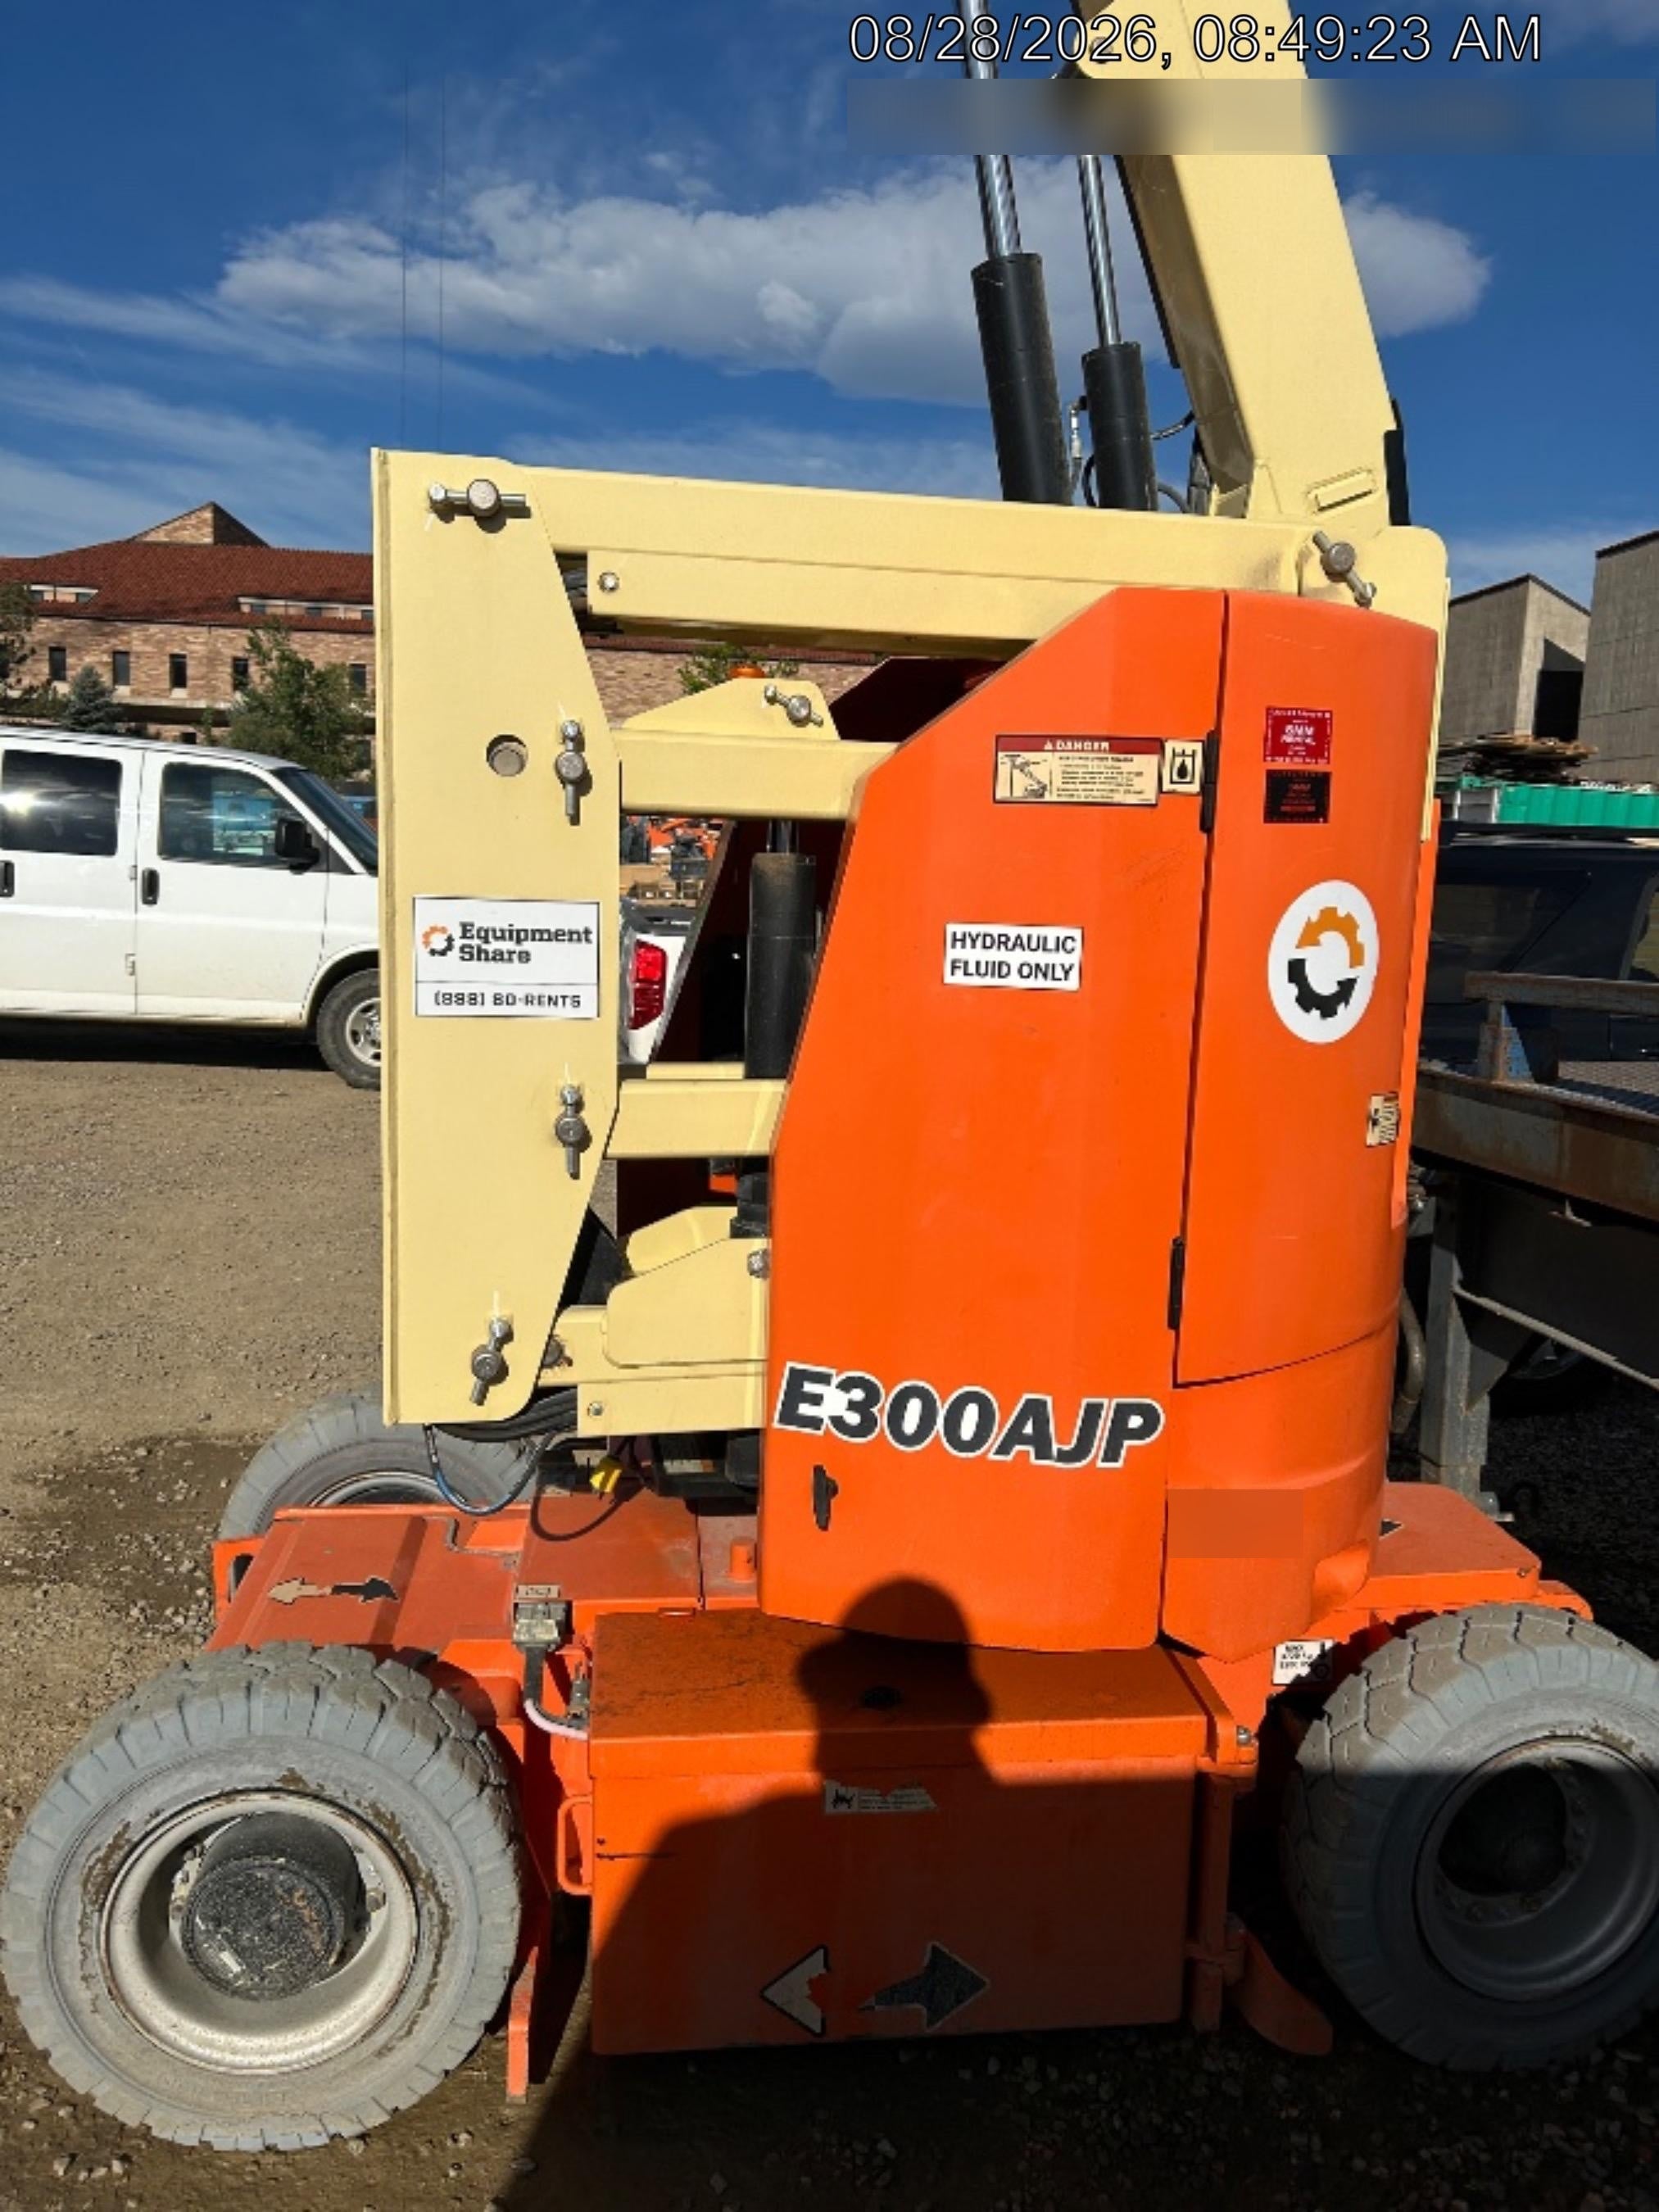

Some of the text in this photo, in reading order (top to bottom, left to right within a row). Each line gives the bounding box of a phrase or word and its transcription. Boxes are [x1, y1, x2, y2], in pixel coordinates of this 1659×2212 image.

[1055, 740, 1110, 752] DANGER
[459, 921, 593, 946] Equipment
[950, 930, 1077, 954] HYDRAULIC
[459, 944, 532, 964] Share
[950, 958, 1075, 982] FLUID ONLY
[774, 1362, 1164, 1467] E300AJP
